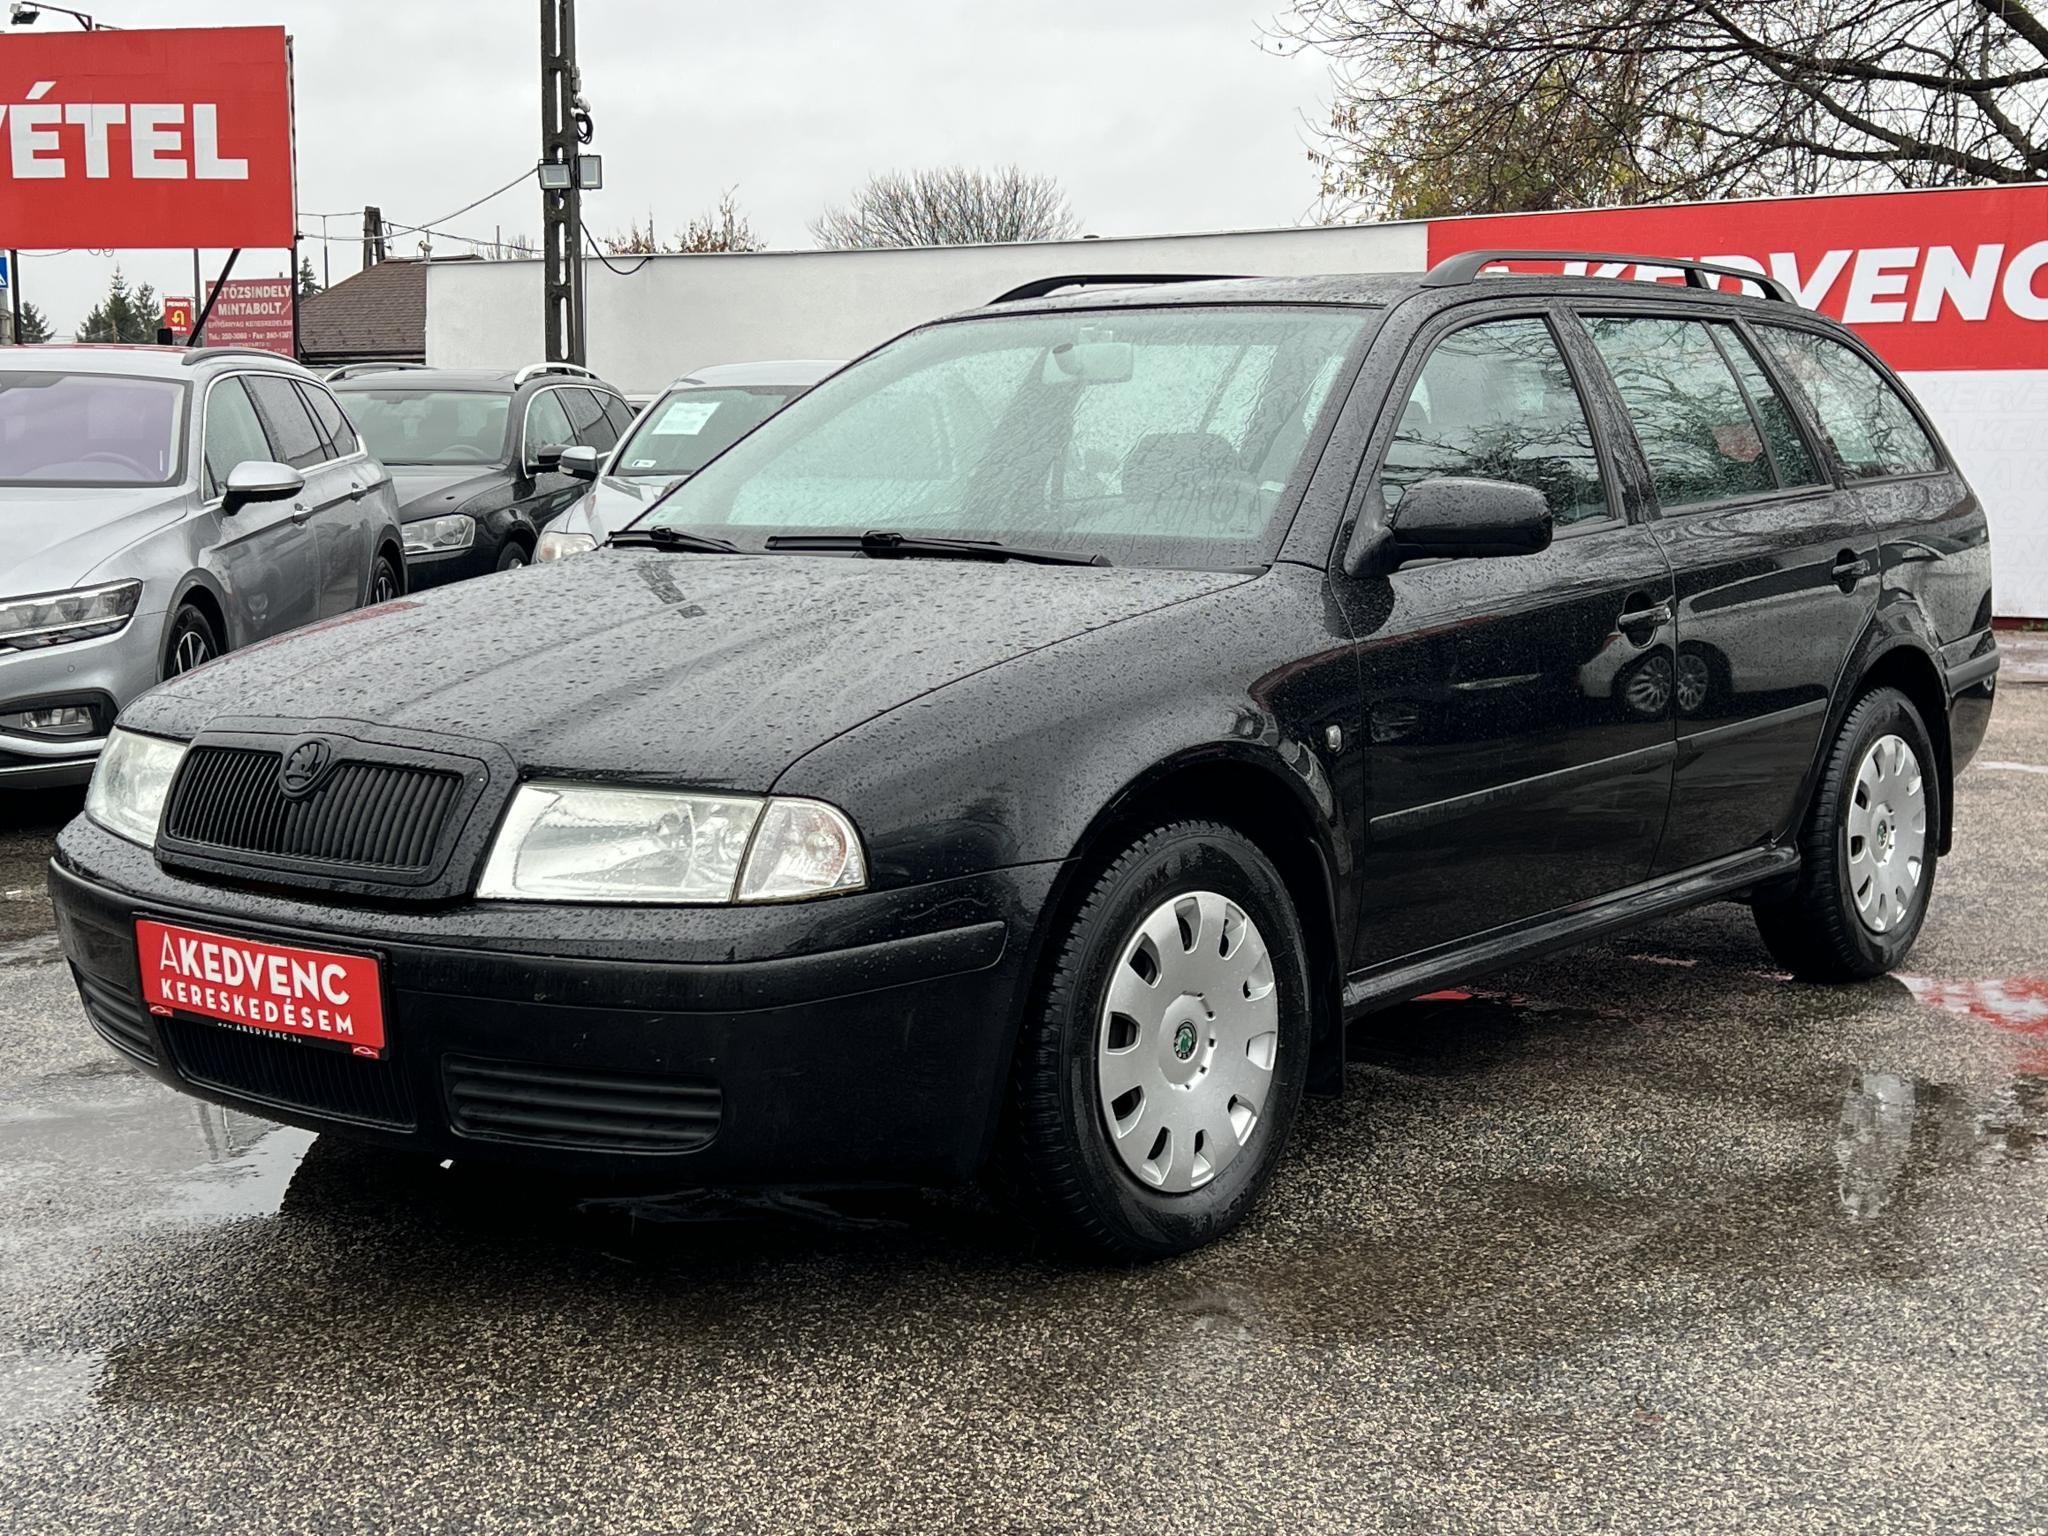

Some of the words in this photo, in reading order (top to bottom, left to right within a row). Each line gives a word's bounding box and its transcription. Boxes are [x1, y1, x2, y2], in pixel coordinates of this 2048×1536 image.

[0, 81, 249, 180] ÉTEL
[217, 301, 282, 316] MINTABOLT
[161, 978, 354, 1036] KERESKEDÉSEM
